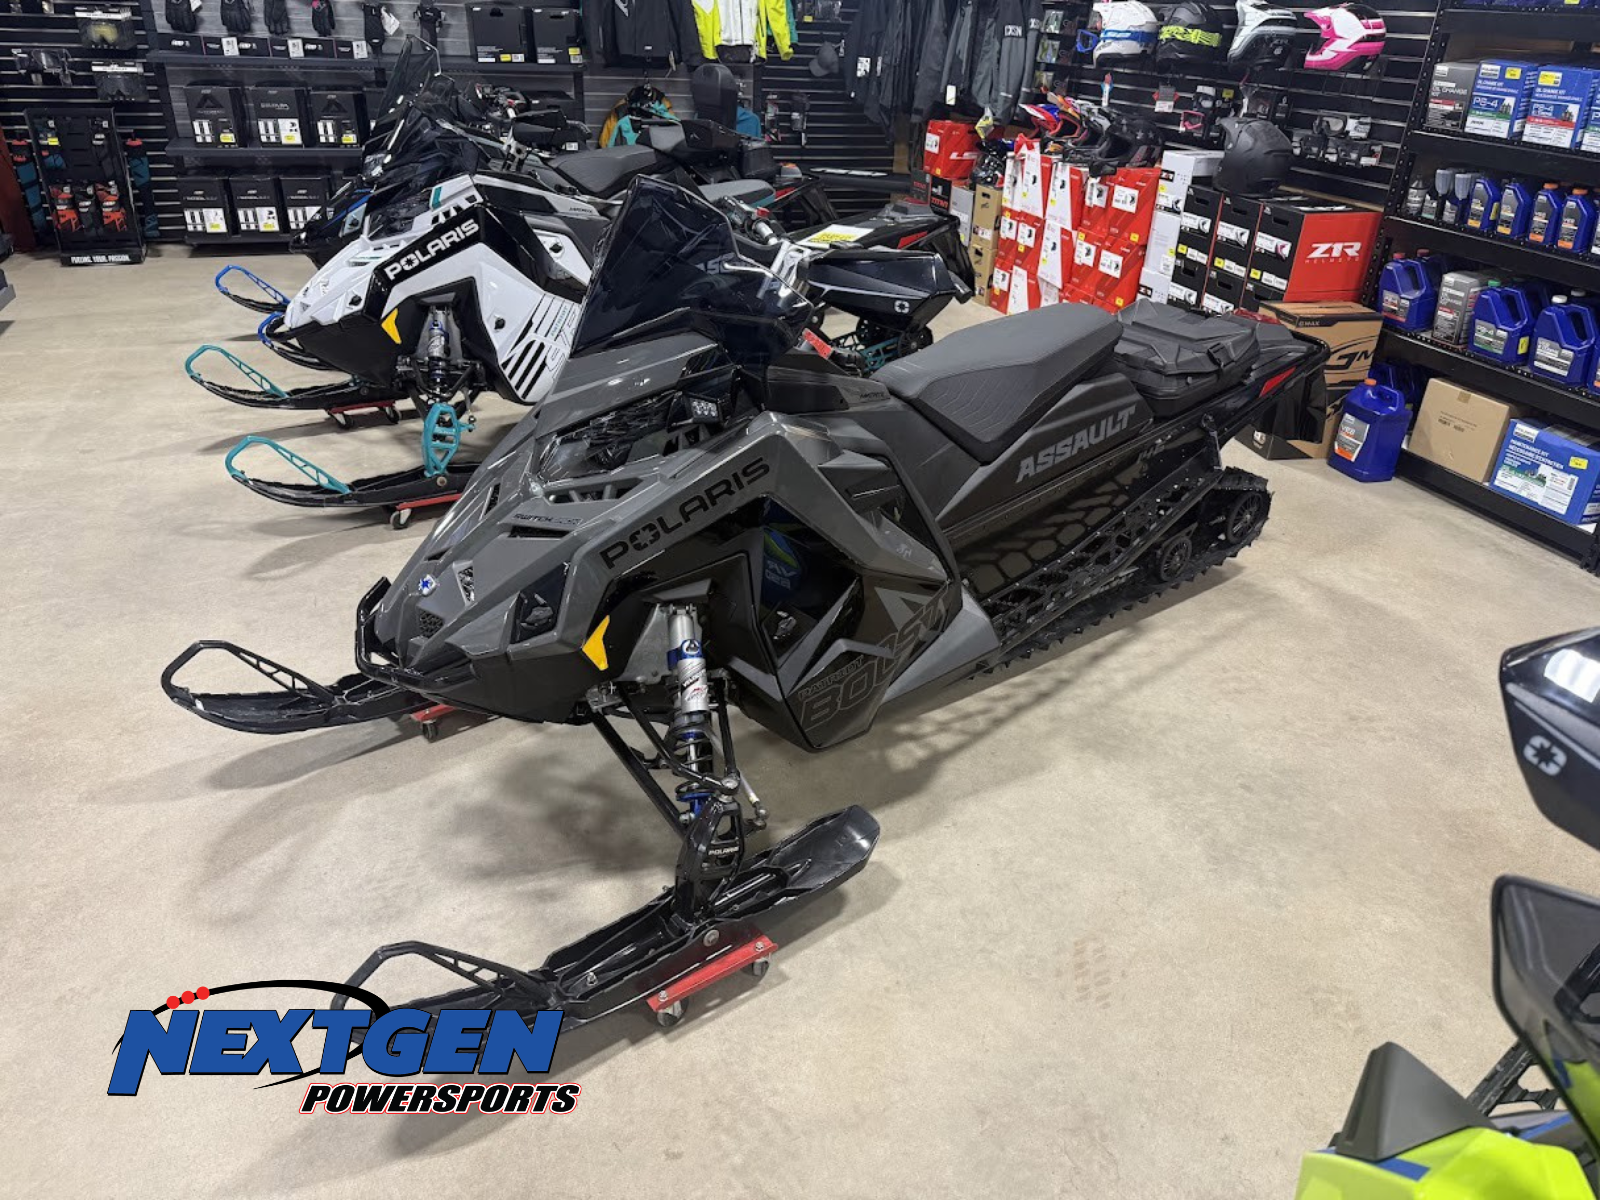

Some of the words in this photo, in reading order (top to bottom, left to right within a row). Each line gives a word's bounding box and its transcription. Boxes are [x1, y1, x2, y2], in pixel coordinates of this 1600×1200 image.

[384, 219, 479, 280] POLARIS
[1015, 405, 1136, 484] ASSAULT
[600, 457, 770, 569] POLARIS
